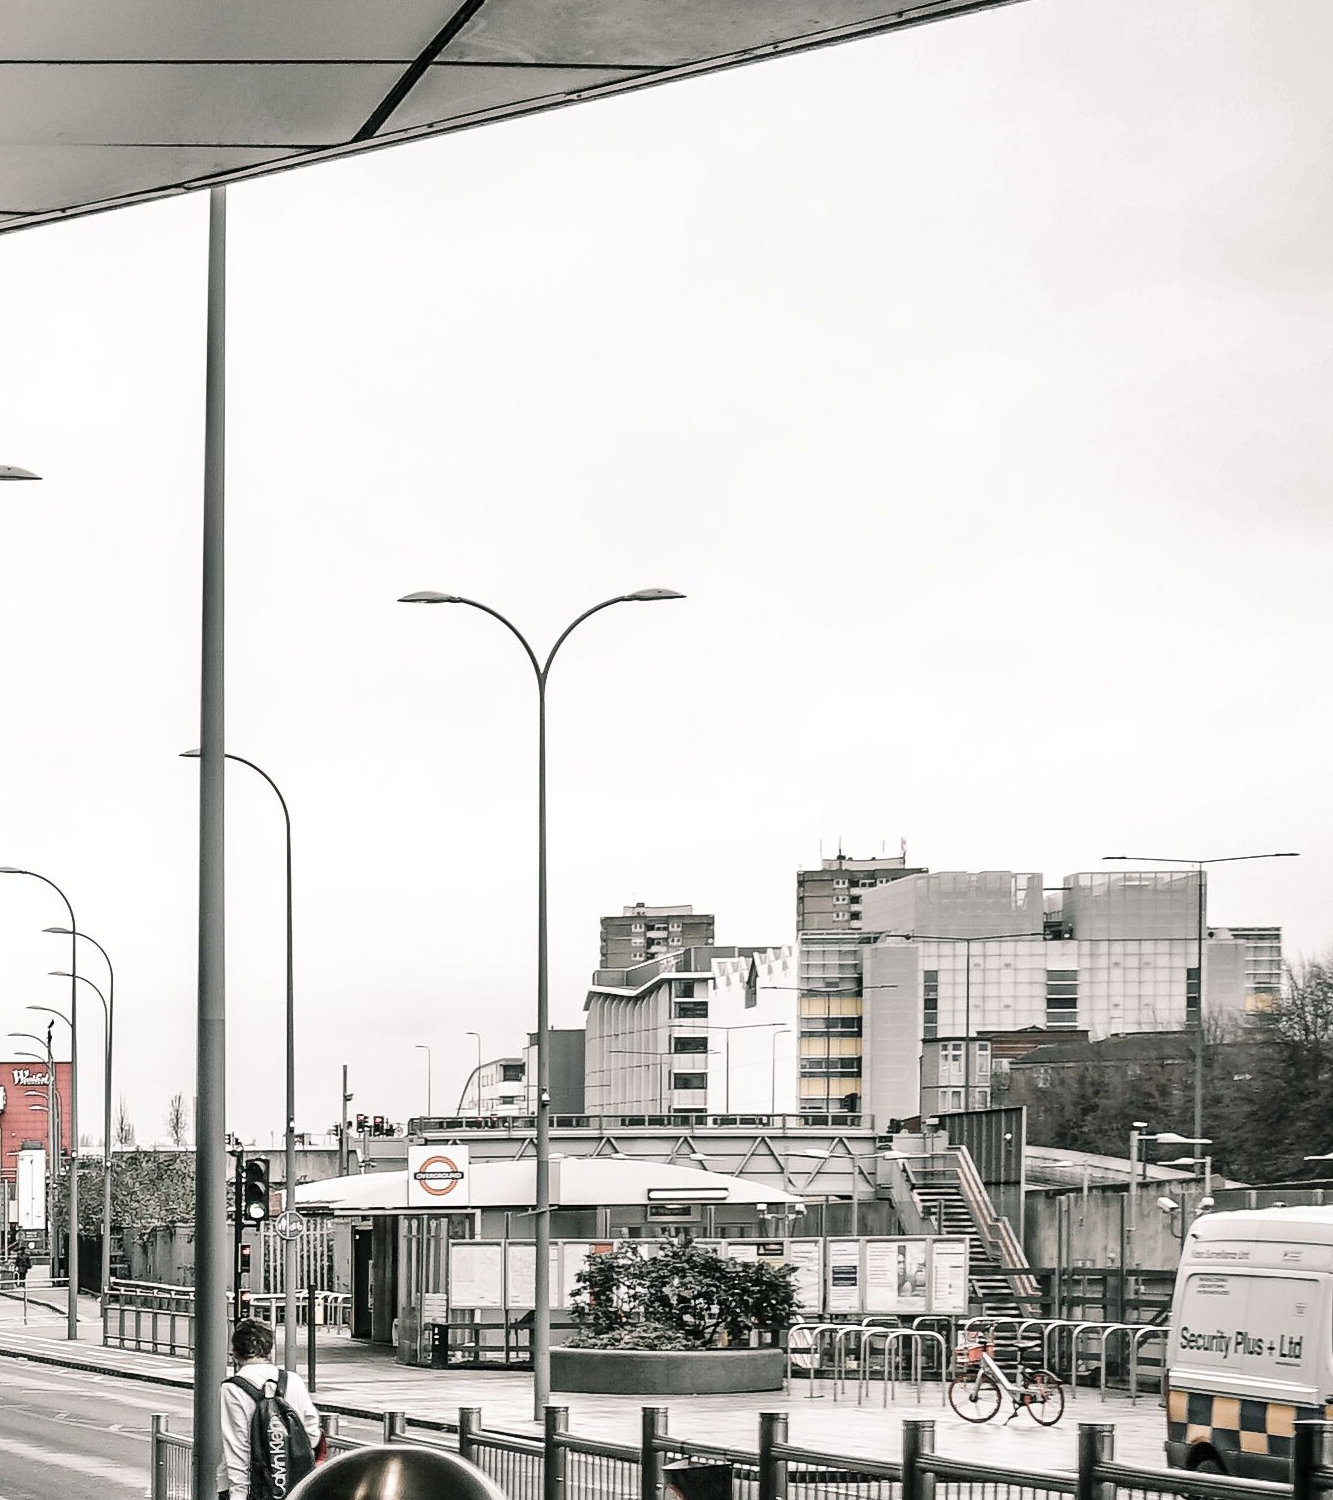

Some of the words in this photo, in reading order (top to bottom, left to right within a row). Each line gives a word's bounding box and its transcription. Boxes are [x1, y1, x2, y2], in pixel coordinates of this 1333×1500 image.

[1180, 1326, 1232, 1359] Security
[1234, 1331, 1264, 1356] Plus
[1278, 1334, 1303, 1359] Ltd
[271, 1454, 287, 1500] Calvin
